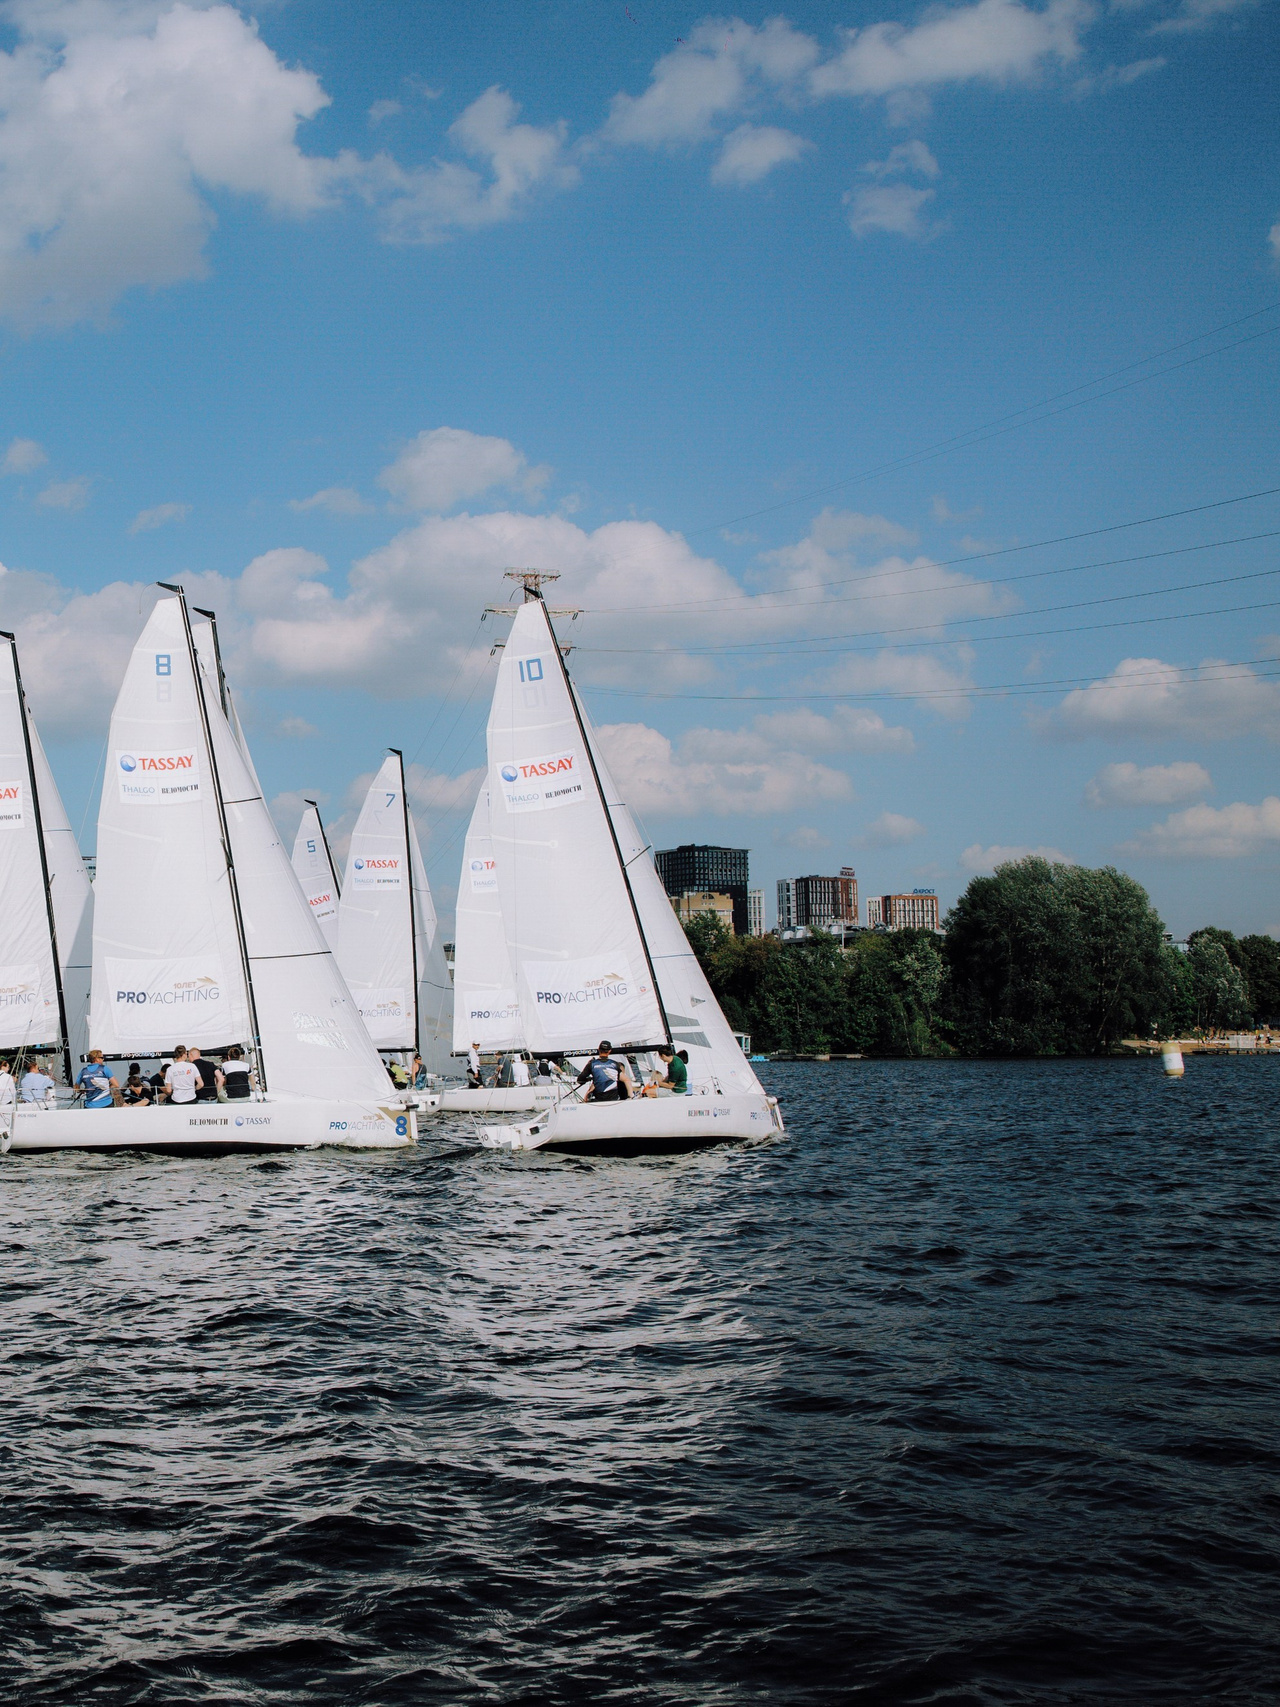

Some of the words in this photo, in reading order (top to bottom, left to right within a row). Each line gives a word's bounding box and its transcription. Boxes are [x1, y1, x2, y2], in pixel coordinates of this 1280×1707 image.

[155, 654, 172, 676] 8
[518, 658, 544, 683] 10
[138, 755, 194, 771] TASSAY
[519, 756, 574, 778] TASSAY
[122, 784, 155, 794] THALGO
[385, 793, 396, 807] 7
[506, 792, 540, 804] THALGO
[306, 840, 316, 853] 5
[365, 859, 400, 869] TASSAY
[309, 894, 331, 906] ASSAY
[116, 987, 220, 1005] PROYACHTING
[536, 982, 628, 1004] PROYACHTING
[245, 1116, 272, 1125] TASSAY
[328, 1120, 386, 1131] PROYACHTING
[394, 1115, 408, 1136] 8
